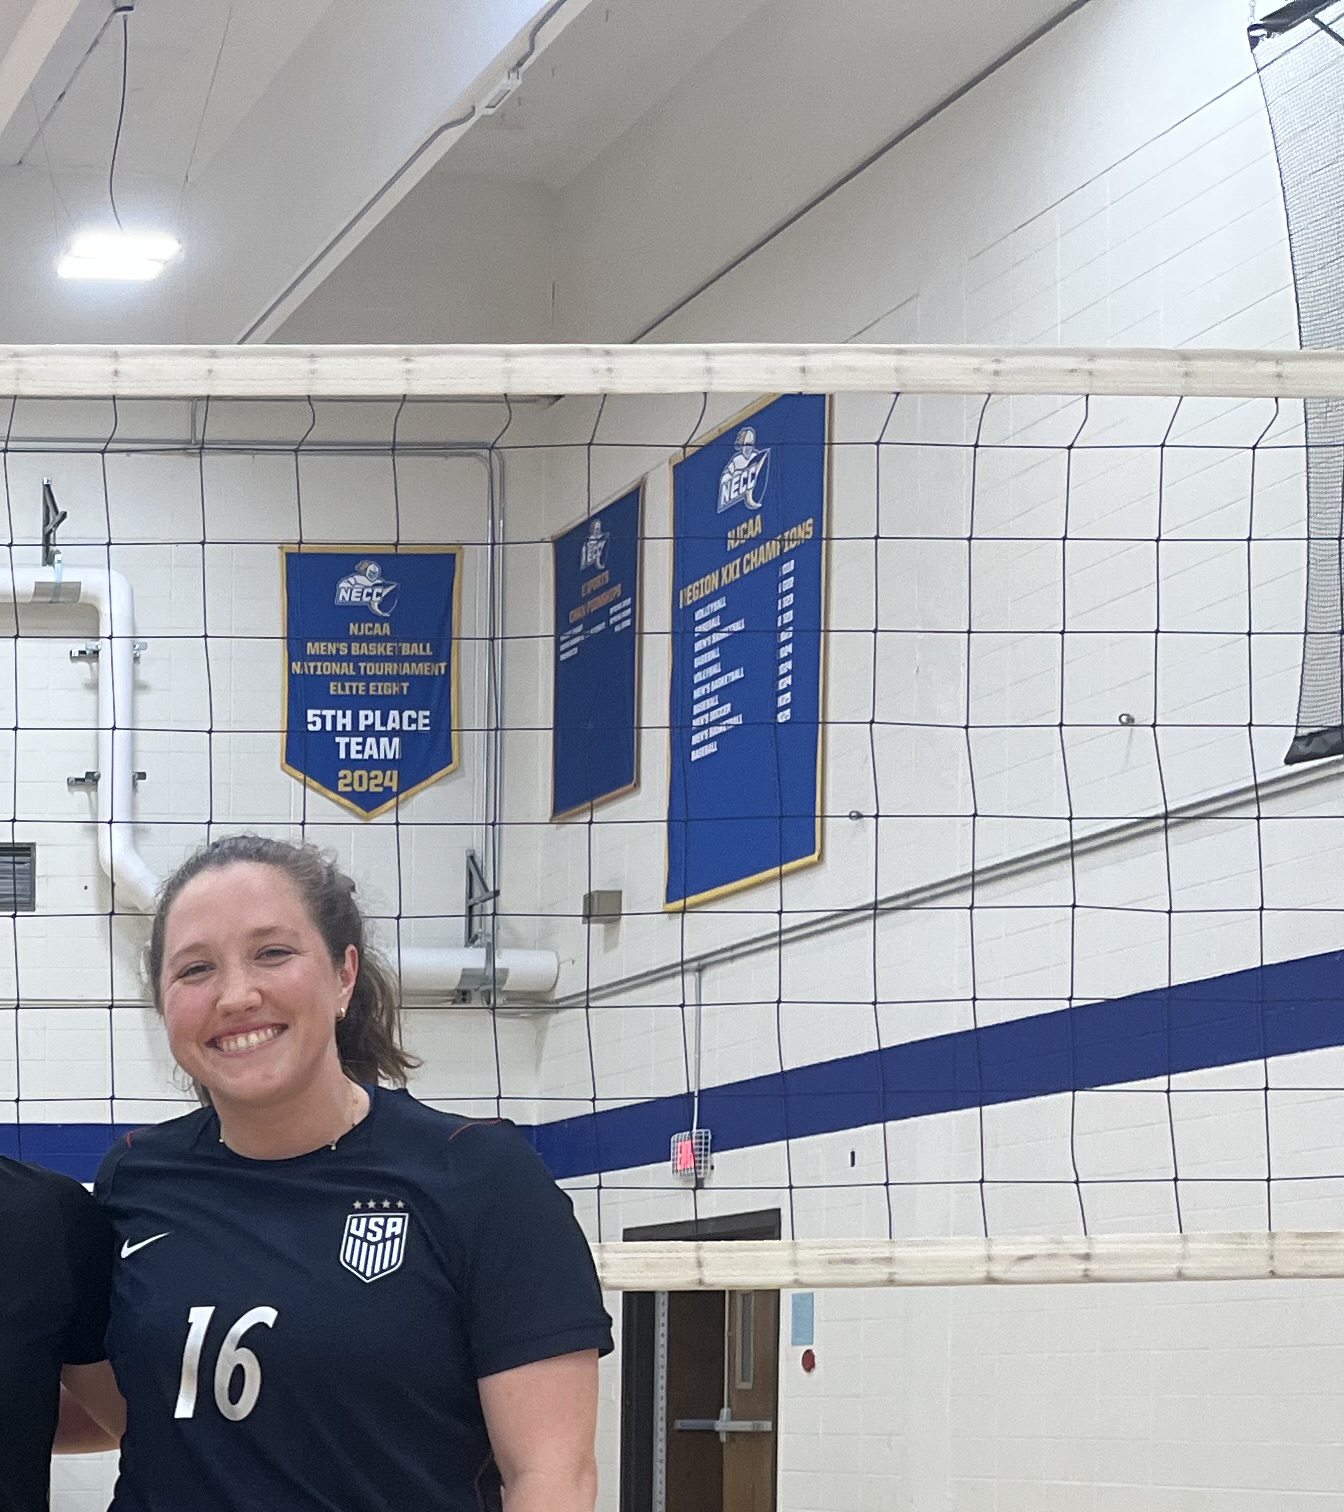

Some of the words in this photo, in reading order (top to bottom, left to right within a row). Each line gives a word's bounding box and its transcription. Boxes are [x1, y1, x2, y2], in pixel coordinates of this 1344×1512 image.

[721, 465, 756, 506] NECC
[721, 558, 741, 587] XXI
[339, 587, 383, 602] NECC
[349, 623, 391, 636] NJCAA
[307, 643, 348, 656] MEN'S
[351, 643, 433, 656] BASKETBALL
[291, 662, 356, 675] NATIONAL
[358, 662, 448, 676] TOURNAMENT
[330, 682, 366, 695] ELITE
[369, 682, 410, 695] EIGHT
[307, 710, 352, 731] 5TH
[359, 710, 431, 731] PLACE
[335, 737, 402, 760] TEAM
[338, 770, 399, 793] 2024
[350, 1217, 403, 1242] USA
[172, 1305, 278, 1422] 16
